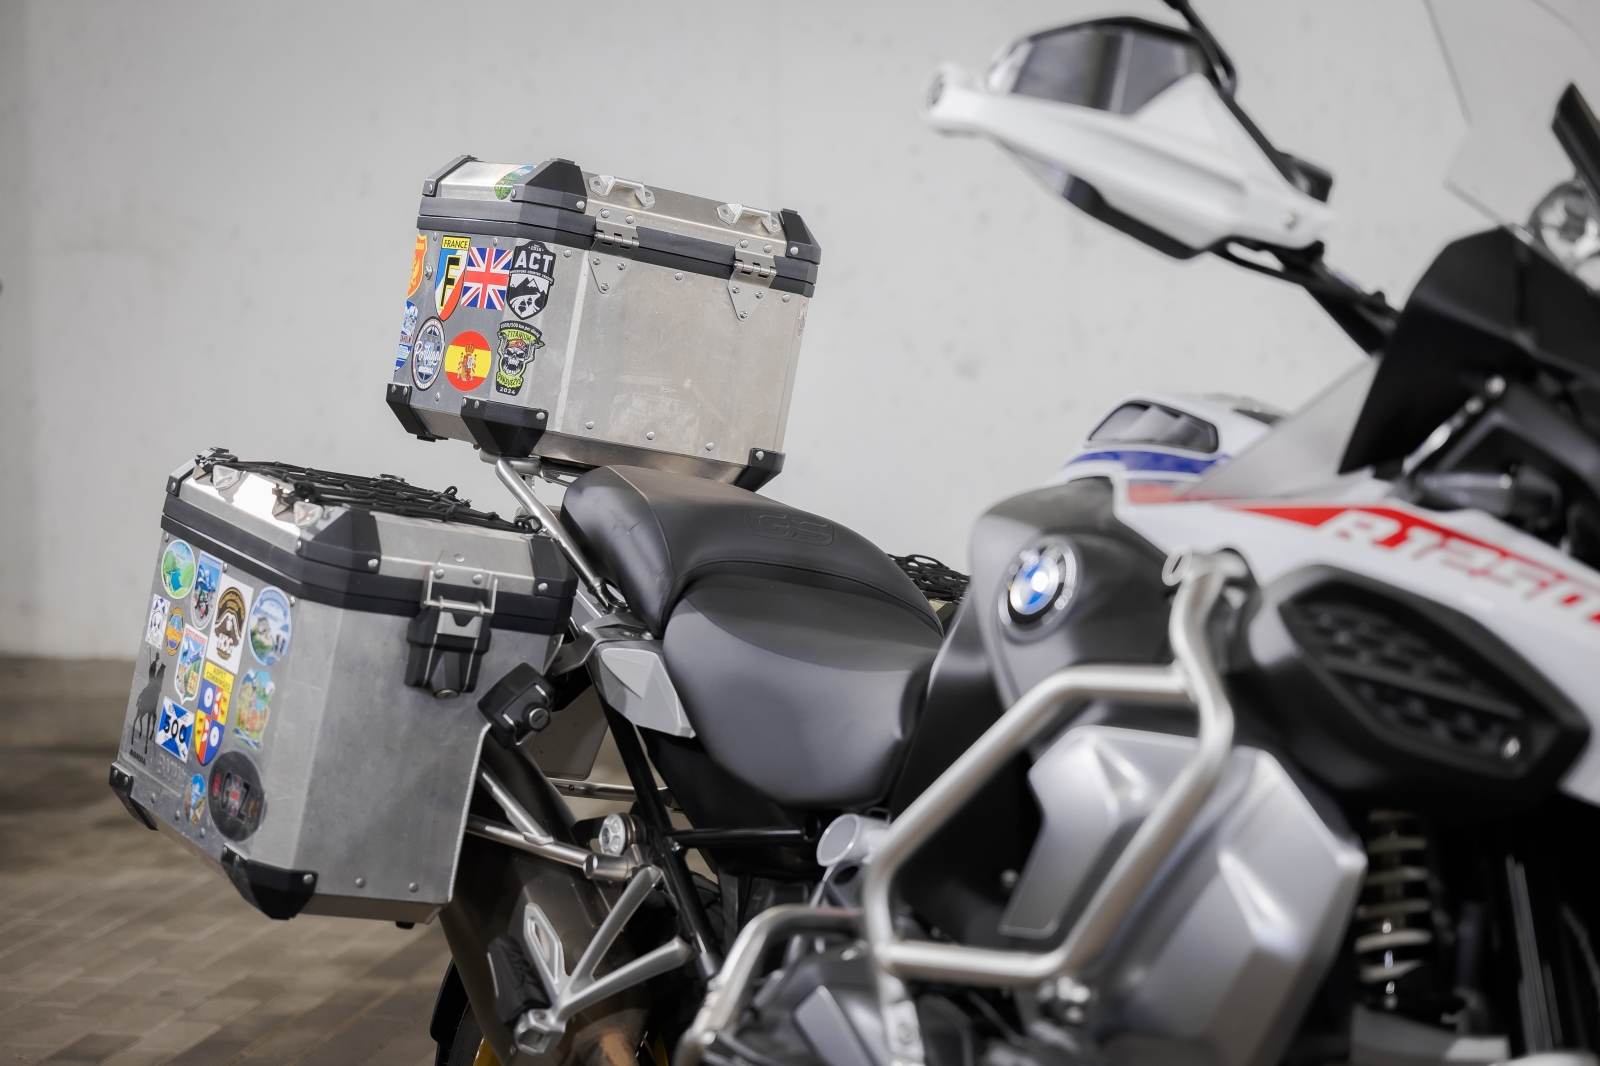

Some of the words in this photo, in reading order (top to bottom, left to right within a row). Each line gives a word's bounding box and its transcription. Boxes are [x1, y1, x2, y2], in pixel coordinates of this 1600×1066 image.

[443, 239, 469, 249] FRANCE
[514, 249, 554, 274] ACT
[440, 255, 462, 309] F
[499, 386, 516, 395] 2024
[750, 513, 830, 543] GS
[163, 713, 187, 744] 500
[129, 748, 147, 766] RONDA
